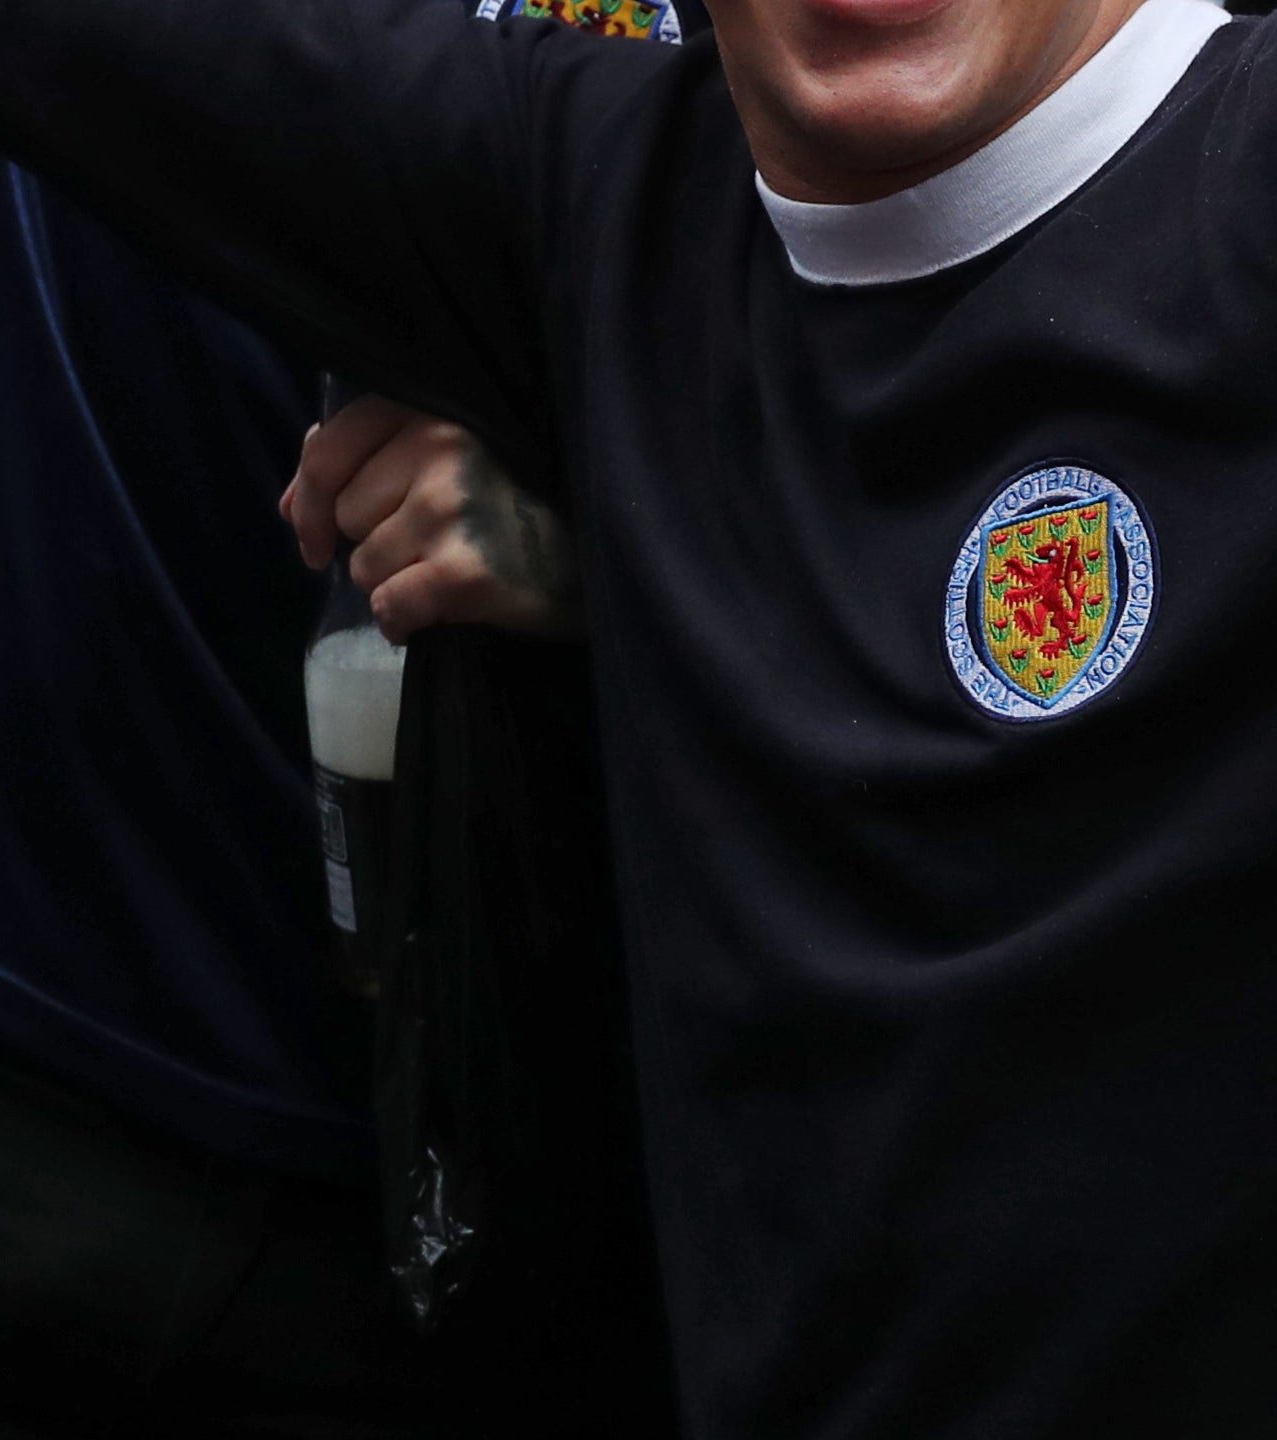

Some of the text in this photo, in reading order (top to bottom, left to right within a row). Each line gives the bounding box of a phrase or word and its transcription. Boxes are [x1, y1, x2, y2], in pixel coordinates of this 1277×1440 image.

[947, 468, 1152, 711] THE SCOTTISH FOOTBALL ASSOCIATION
